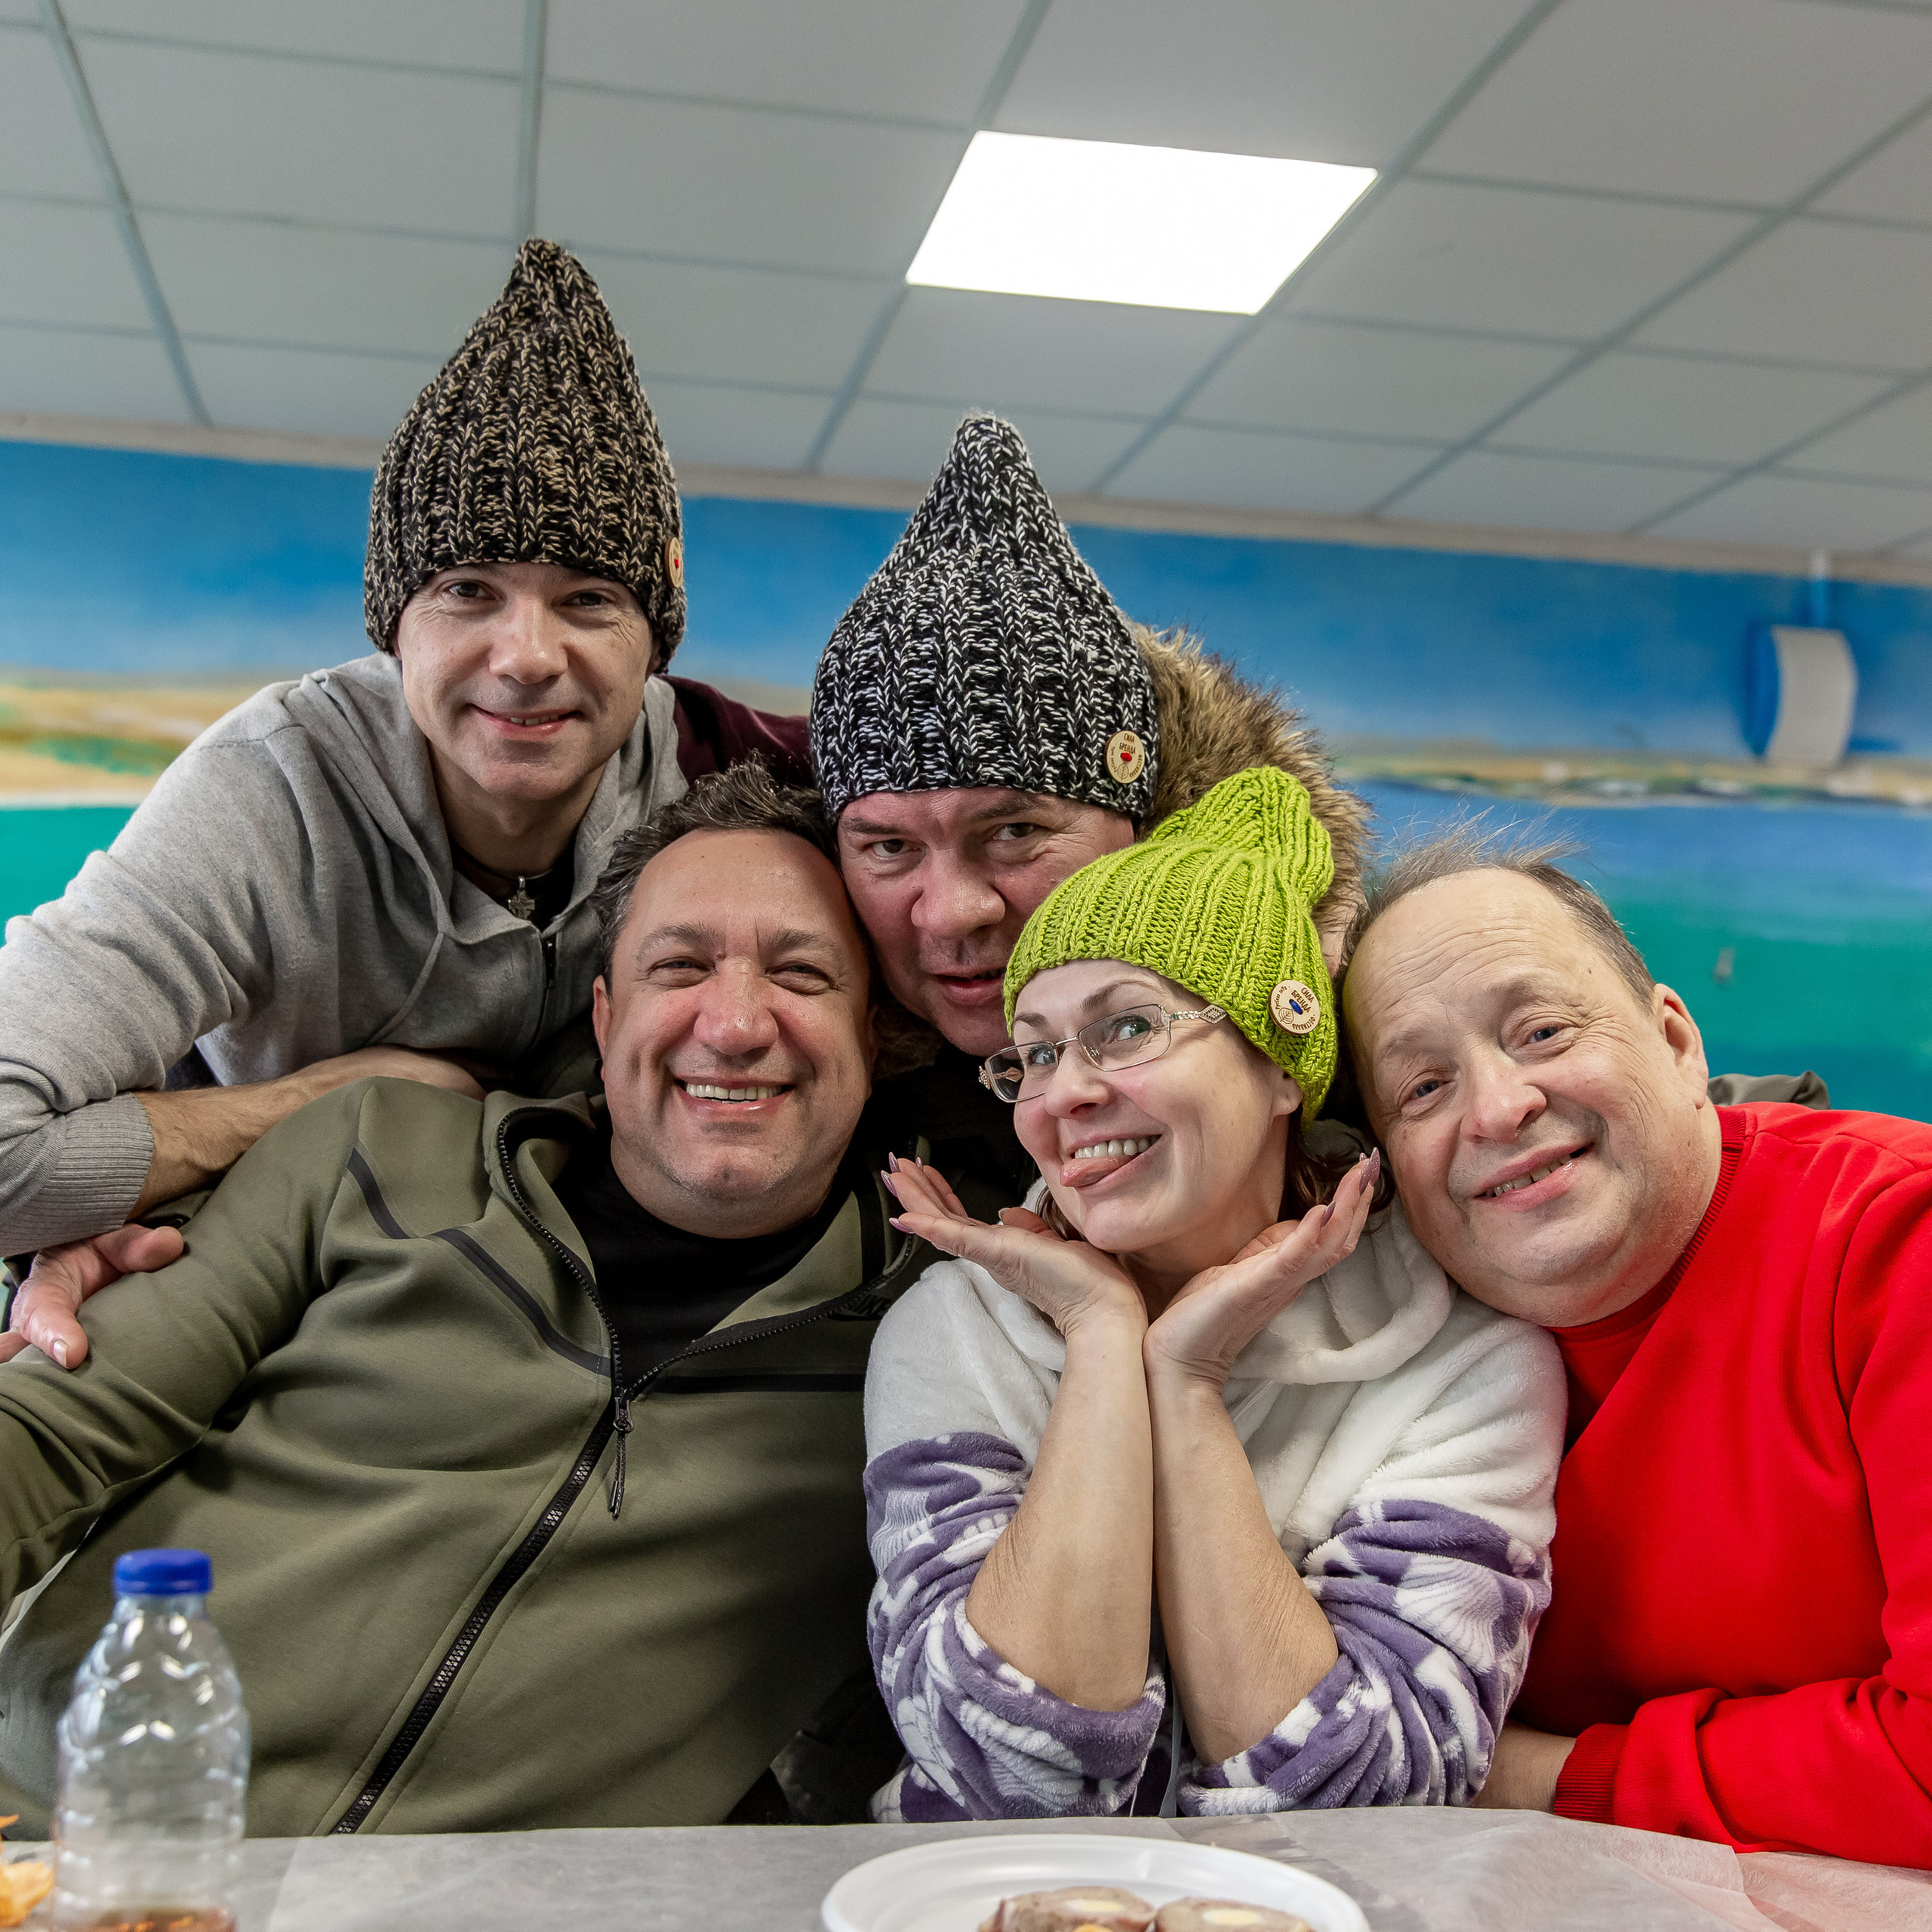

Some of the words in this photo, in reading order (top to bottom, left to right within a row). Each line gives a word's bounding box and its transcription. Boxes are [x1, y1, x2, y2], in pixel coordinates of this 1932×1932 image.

[1124, 733, 1134, 743] СИЛА
[1119, 742, 1135, 754] БРЕНДА
[1291, 989, 1312, 1013] БРЕНДА
[1301, 987, 1314, 1003] СИЛА
[1292, 1017, 1315, 1030] ФЕСТИВАЛЬ
